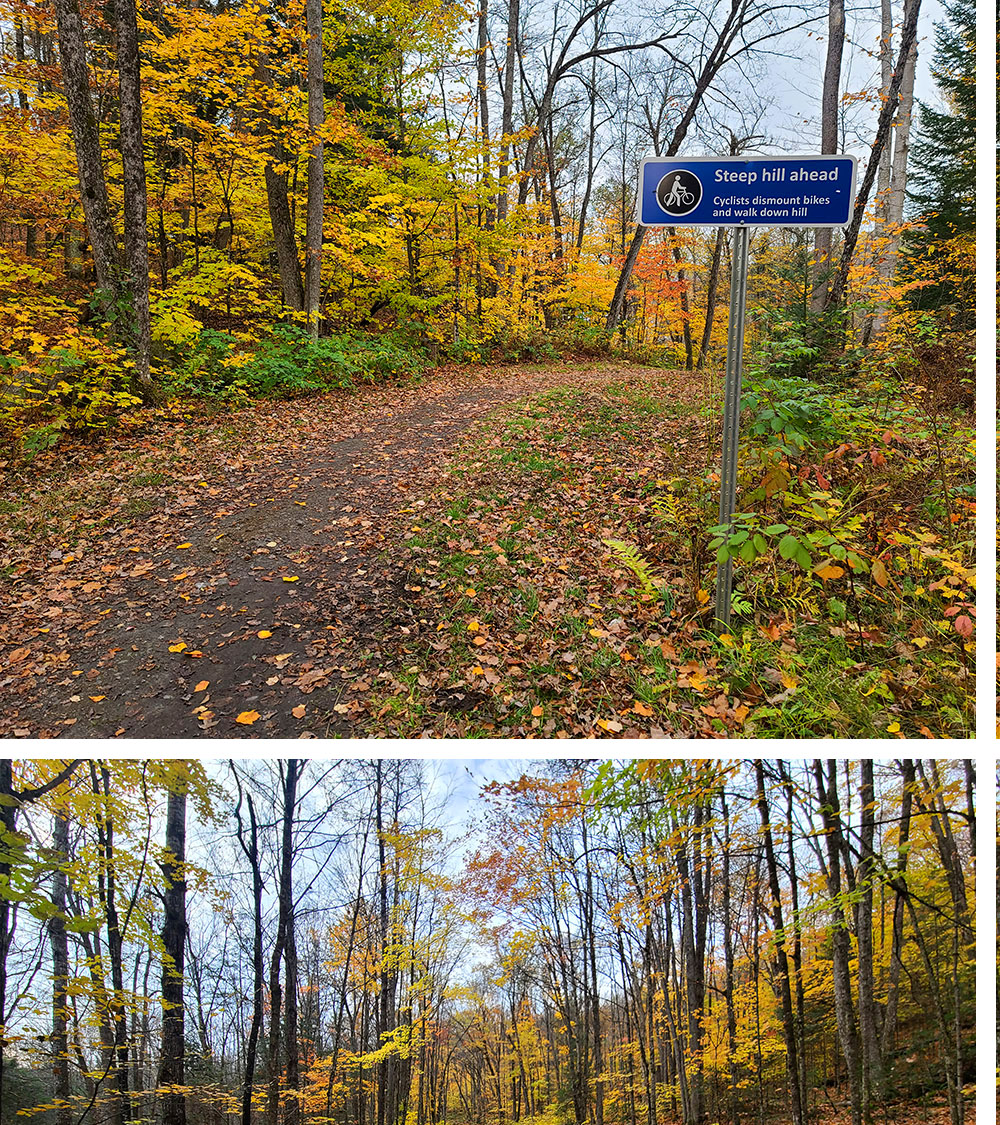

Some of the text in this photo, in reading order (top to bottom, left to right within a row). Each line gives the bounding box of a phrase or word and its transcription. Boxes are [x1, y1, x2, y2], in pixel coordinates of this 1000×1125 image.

[714, 167, 839, 184] Steep hill ahead
[713, 195, 830, 206] Cyclists dismount bikes
[712, 207, 808, 217] and walk down hill
